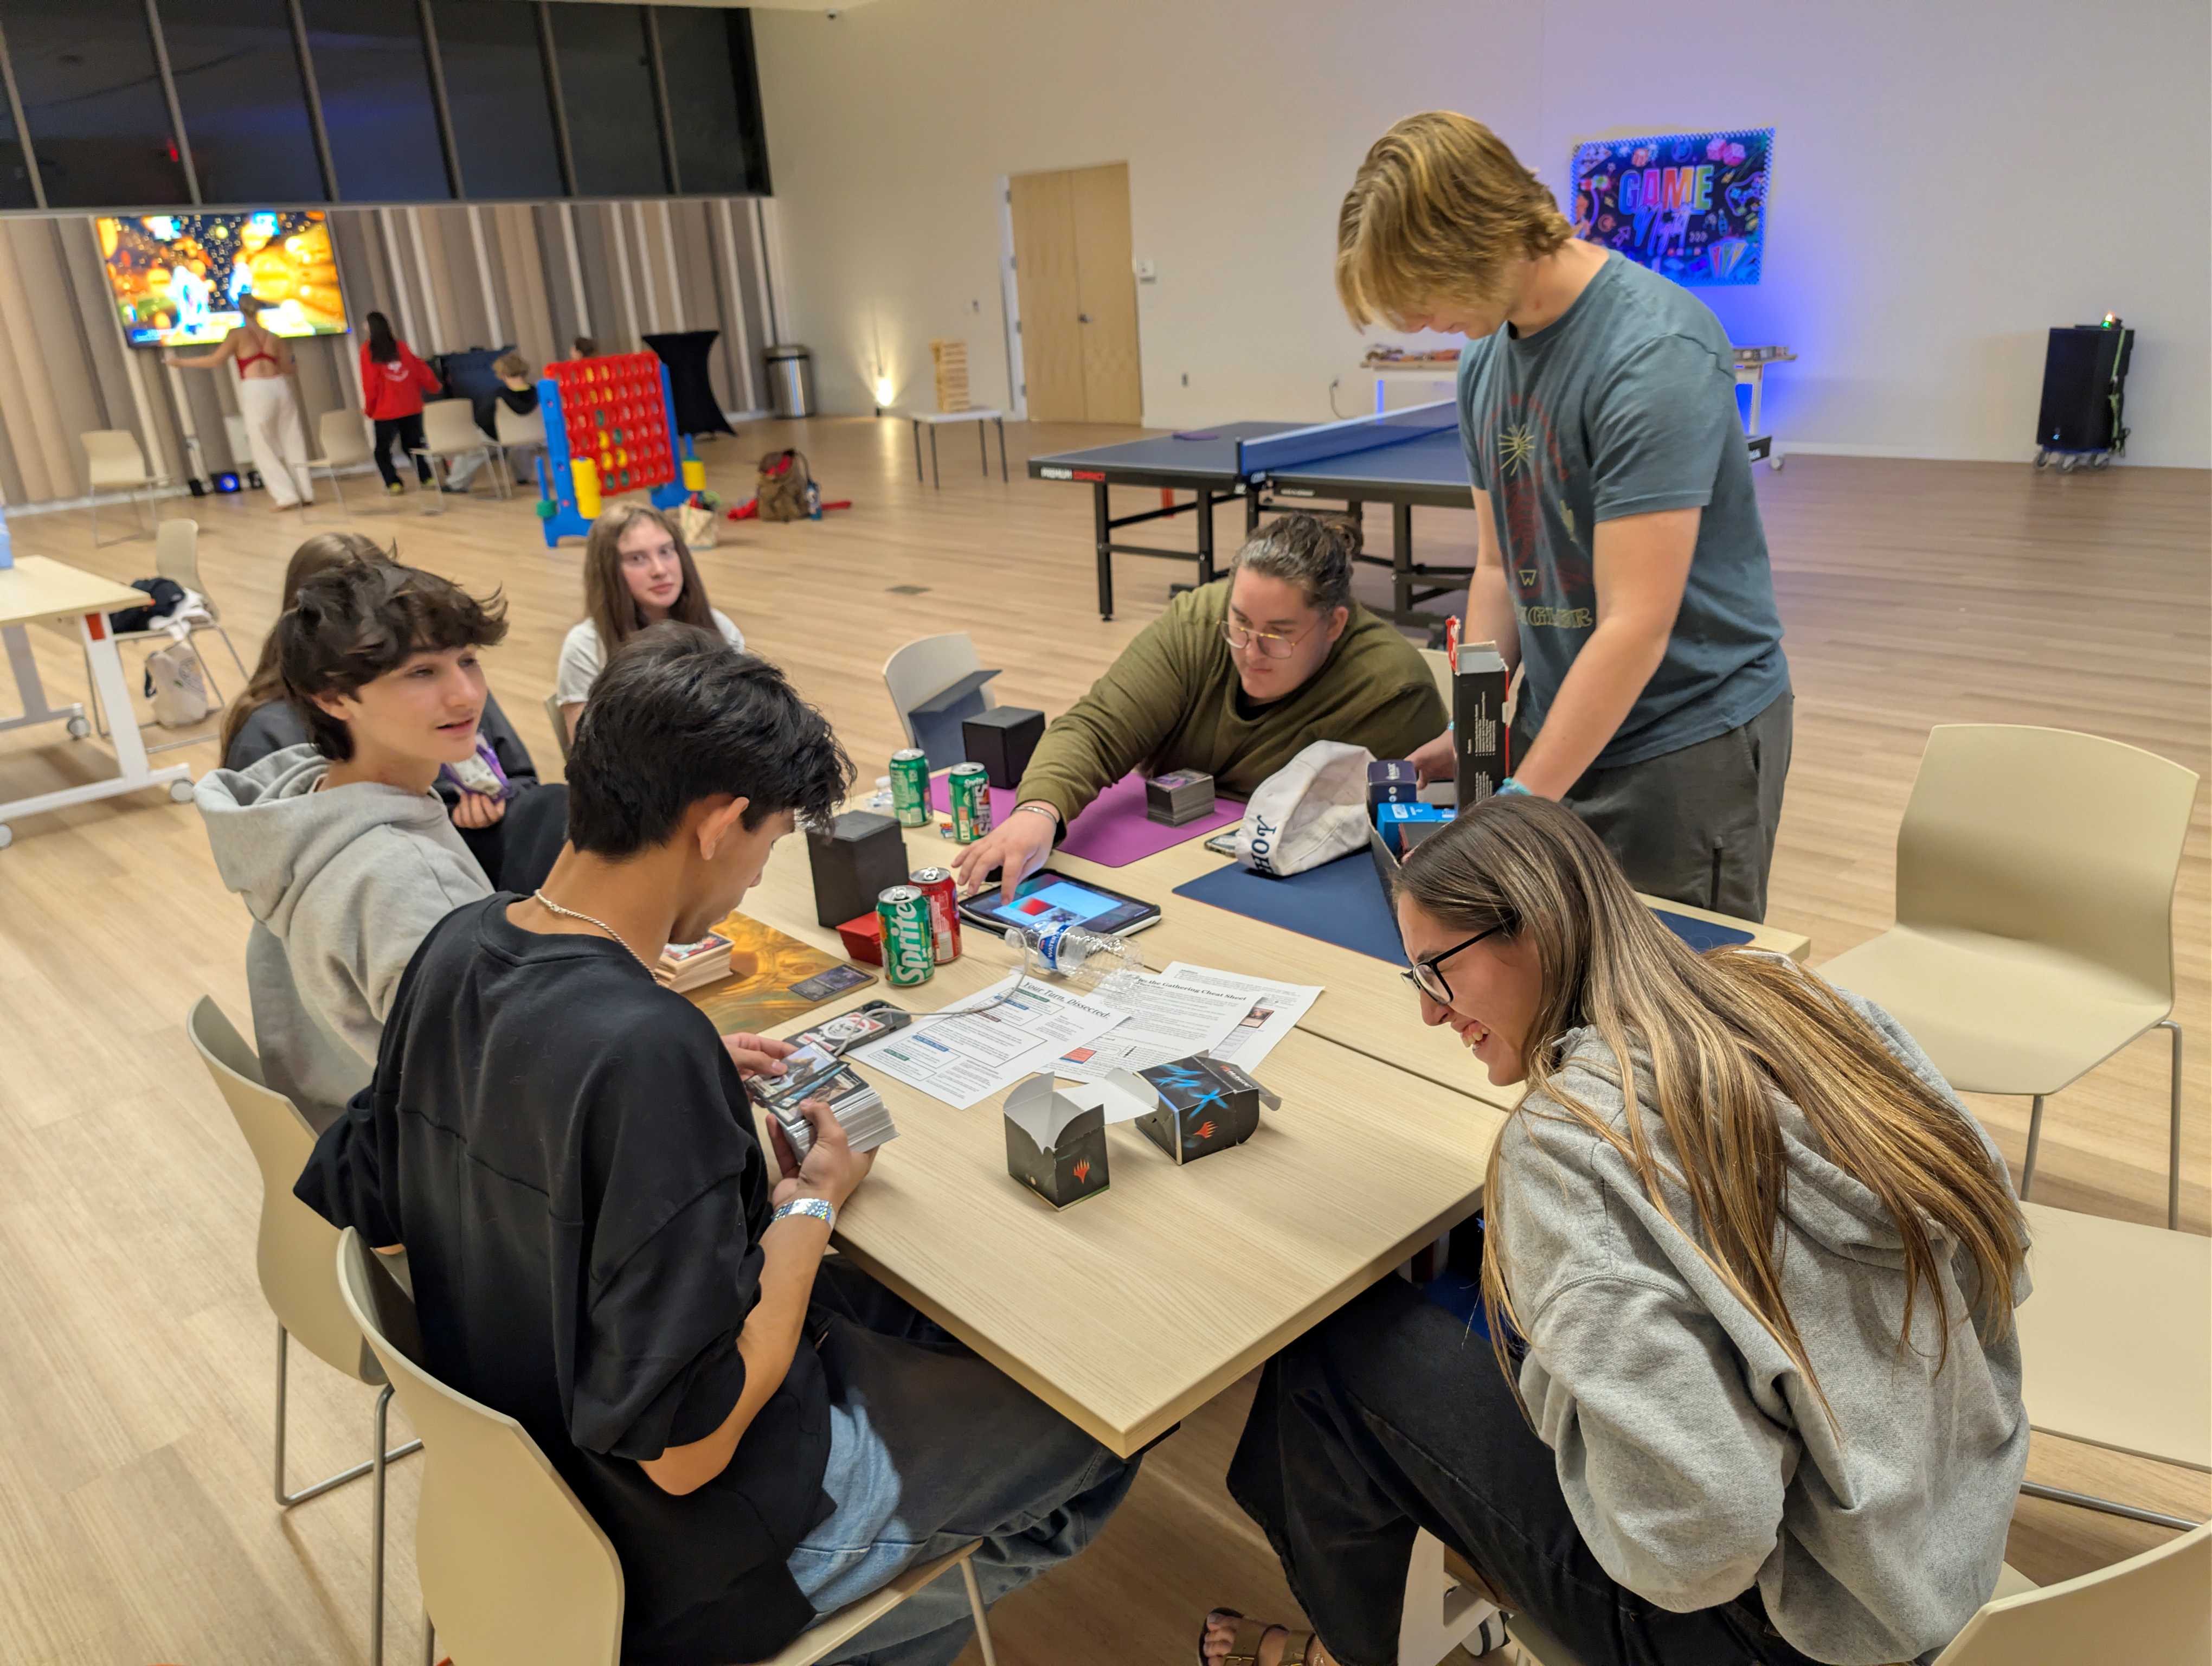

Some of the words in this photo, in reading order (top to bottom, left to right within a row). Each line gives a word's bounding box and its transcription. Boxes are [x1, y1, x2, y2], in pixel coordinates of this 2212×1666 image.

[1618, 164, 1714, 215] GAME
[1251, 815, 1277, 874] HOY
[889, 902, 929, 984] Sprite
[1024, 982, 1046, 995] Your
[1044, 988, 1065, 1002] Turn,
[1067, 998, 1110, 1018] Dissected:
[1163, 982, 1200, 994] Gathering
[1201, 989, 1223, 997] Cheat
